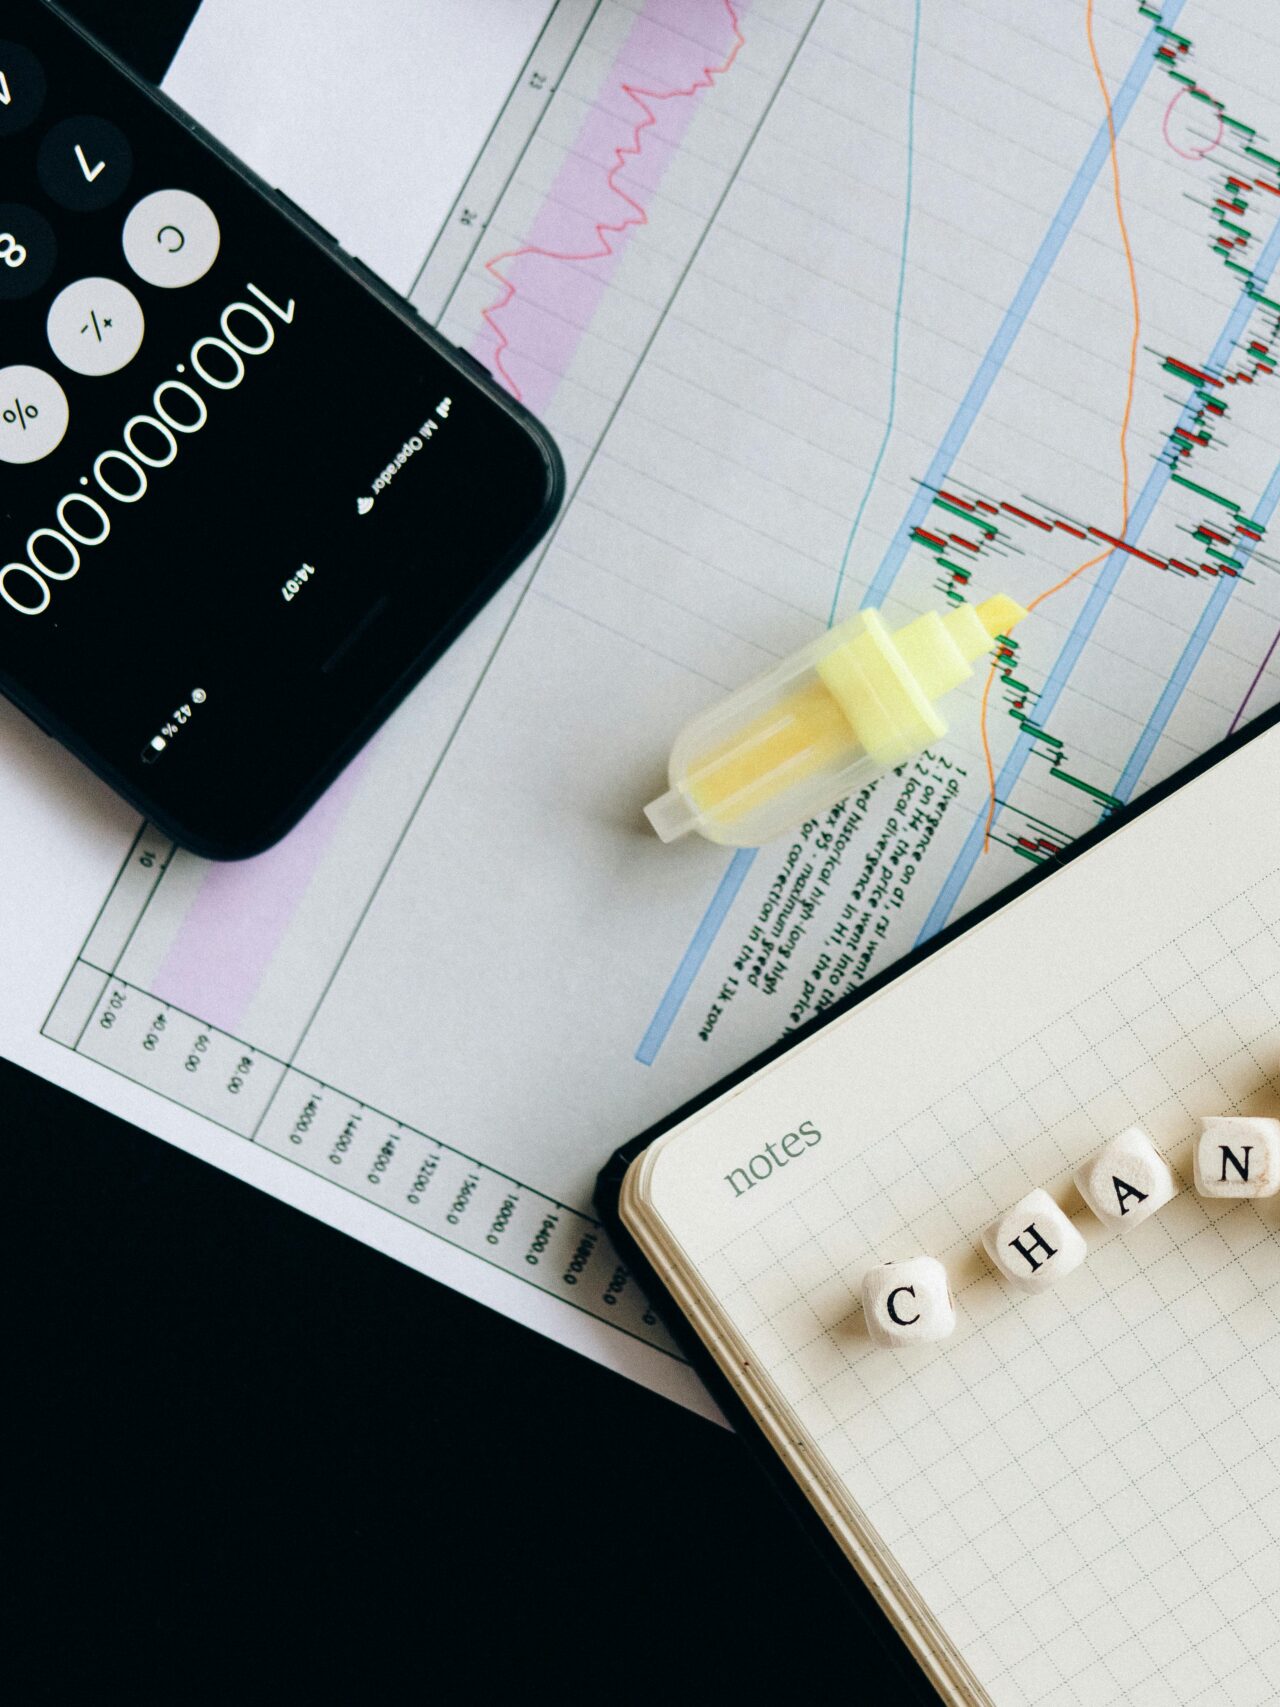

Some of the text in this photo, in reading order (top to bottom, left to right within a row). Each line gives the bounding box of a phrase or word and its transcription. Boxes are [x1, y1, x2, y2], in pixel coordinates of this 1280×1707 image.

[71, 143, 106, 183] 7
[155, 223, 187, 255] C
[0, 396, 40, 432] %
[0, 279, 298, 618] 100.000.000
[370, 418, 439, 496] Mi Operador
[280, 562, 316, 603] 14:07
[173, 703, 193, 725] 42
[955, 767, 968, 777] 1
[893, 776, 922, 817] local
[919, 784, 935, 806] on
[910, 778, 960, 863] divergence
[138, 850, 157, 869] 10
[817, 811, 863, 887] historical
[850, 816, 899, 902] divergence
[889, 838, 910, 867] the
[867, 865, 895, 909] price
[899, 864, 916, 886] on
[746, 830, 834, 988] 95 maximum greed
[840, 903, 859, 921] in
[884, 886, 905, 911] d1,
[697, 818, 820, 1043] for correction in the 13k zone
[845, 911, 873, 952] went
[761, 959, 789, 996] high
[810, 953, 832, 981] the
[828, 952, 855, 987] into
[852, 940, 879, 980] went
[99, 990, 127, 1030] 20.00
[789, 979, 816, 1024] price
[142, 1013, 167, 1051] 40.00
[184, 1034, 210, 1073] 60.00
[288, 1093, 323, 1146] 14000.0
[328, 1113, 363, 1165] 14400.0
[366, 1133, 401, 1185] 14800.0
[406, 1153, 441, 1205] 15200.0
[723, 1118, 822, 1199] notes
[445, 1173, 480, 1226] 15600.0
[485, 1193, 520, 1246] 16000.0
[524, 1213, 560, 1266] 16400.0
[562, 1233, 598, 1286] 16800.0
